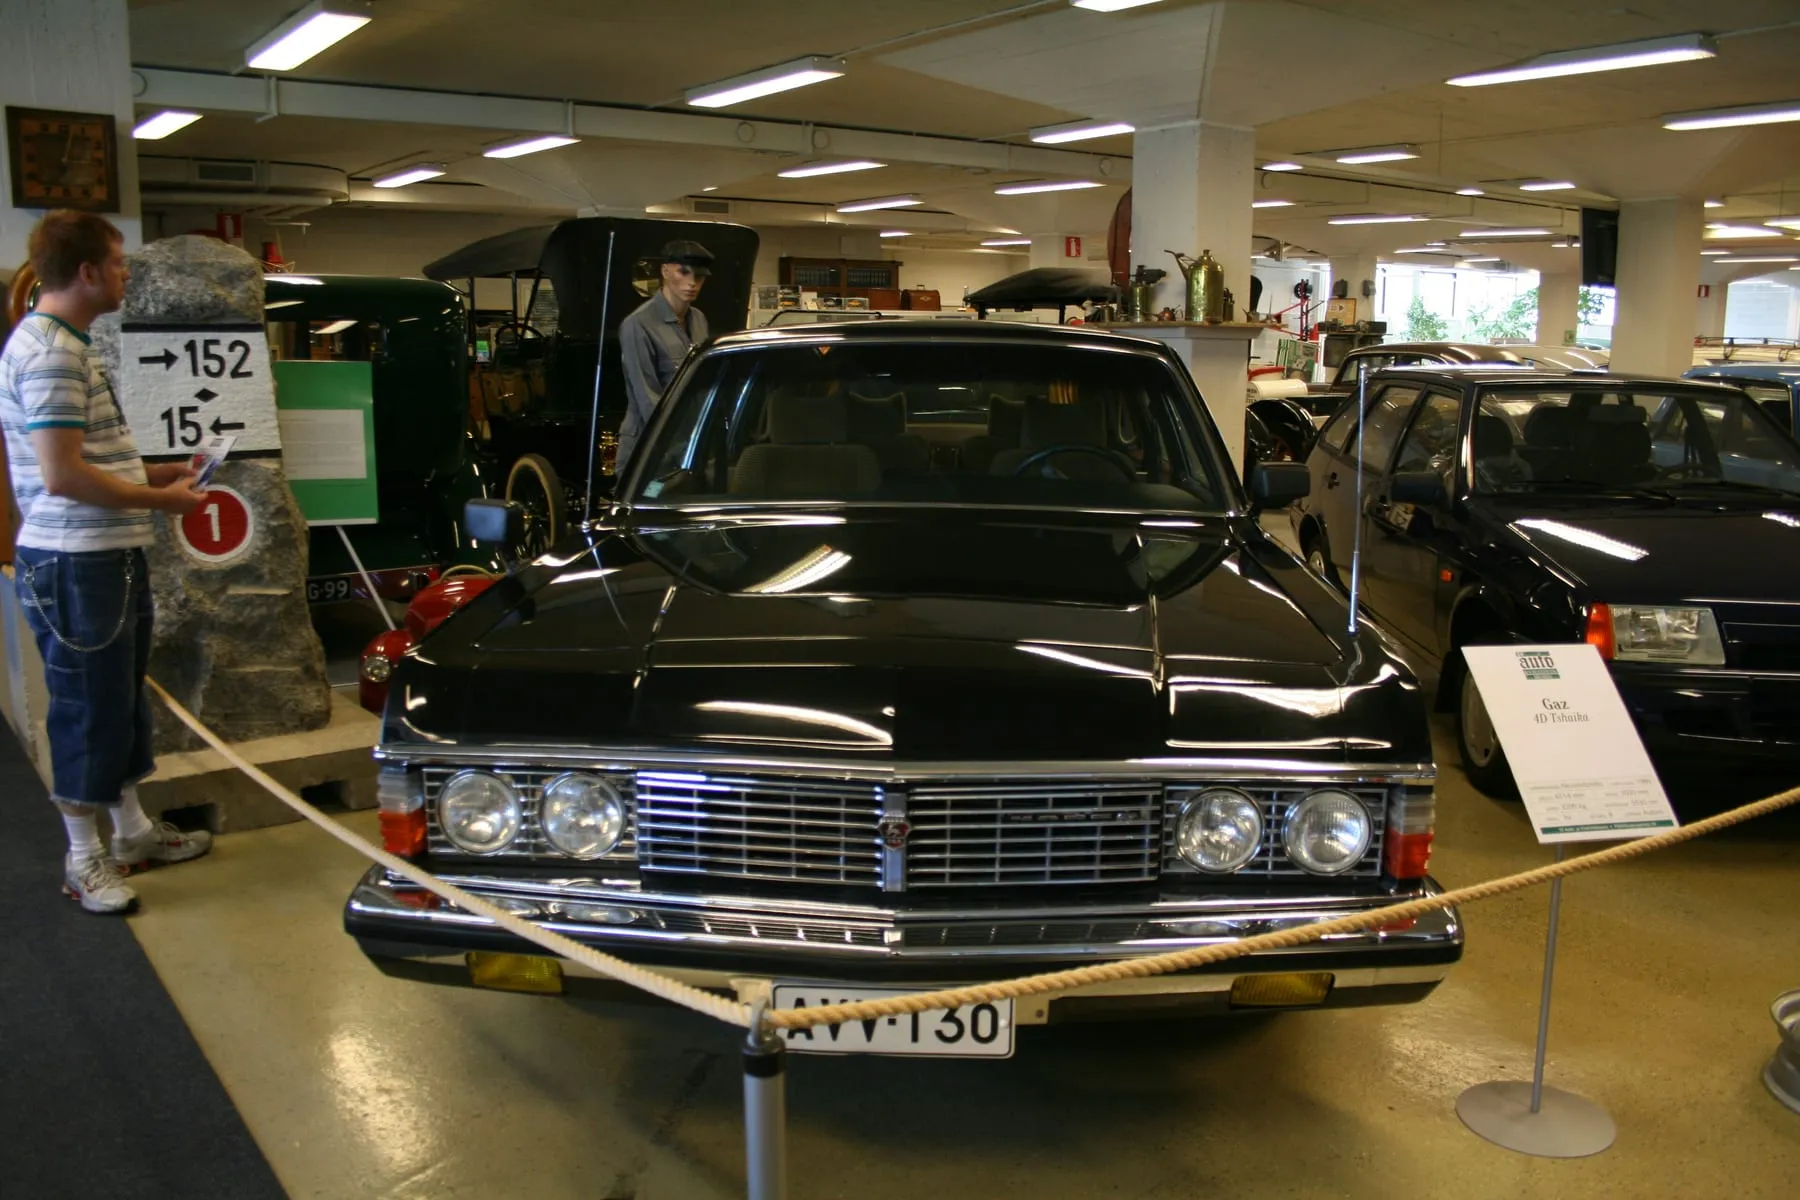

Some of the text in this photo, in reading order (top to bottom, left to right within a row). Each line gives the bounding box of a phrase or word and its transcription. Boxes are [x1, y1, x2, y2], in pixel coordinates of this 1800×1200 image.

[184, 339, 253, 379] 152
[160, 405, 203, 448] 15
[204, 503, 221, 542] 1
[1519, 656, 1554, 669] auto
[1534, 711, 1589, 724] 4D Tshaika
[1542, 698, 1570, 711] Gaz
